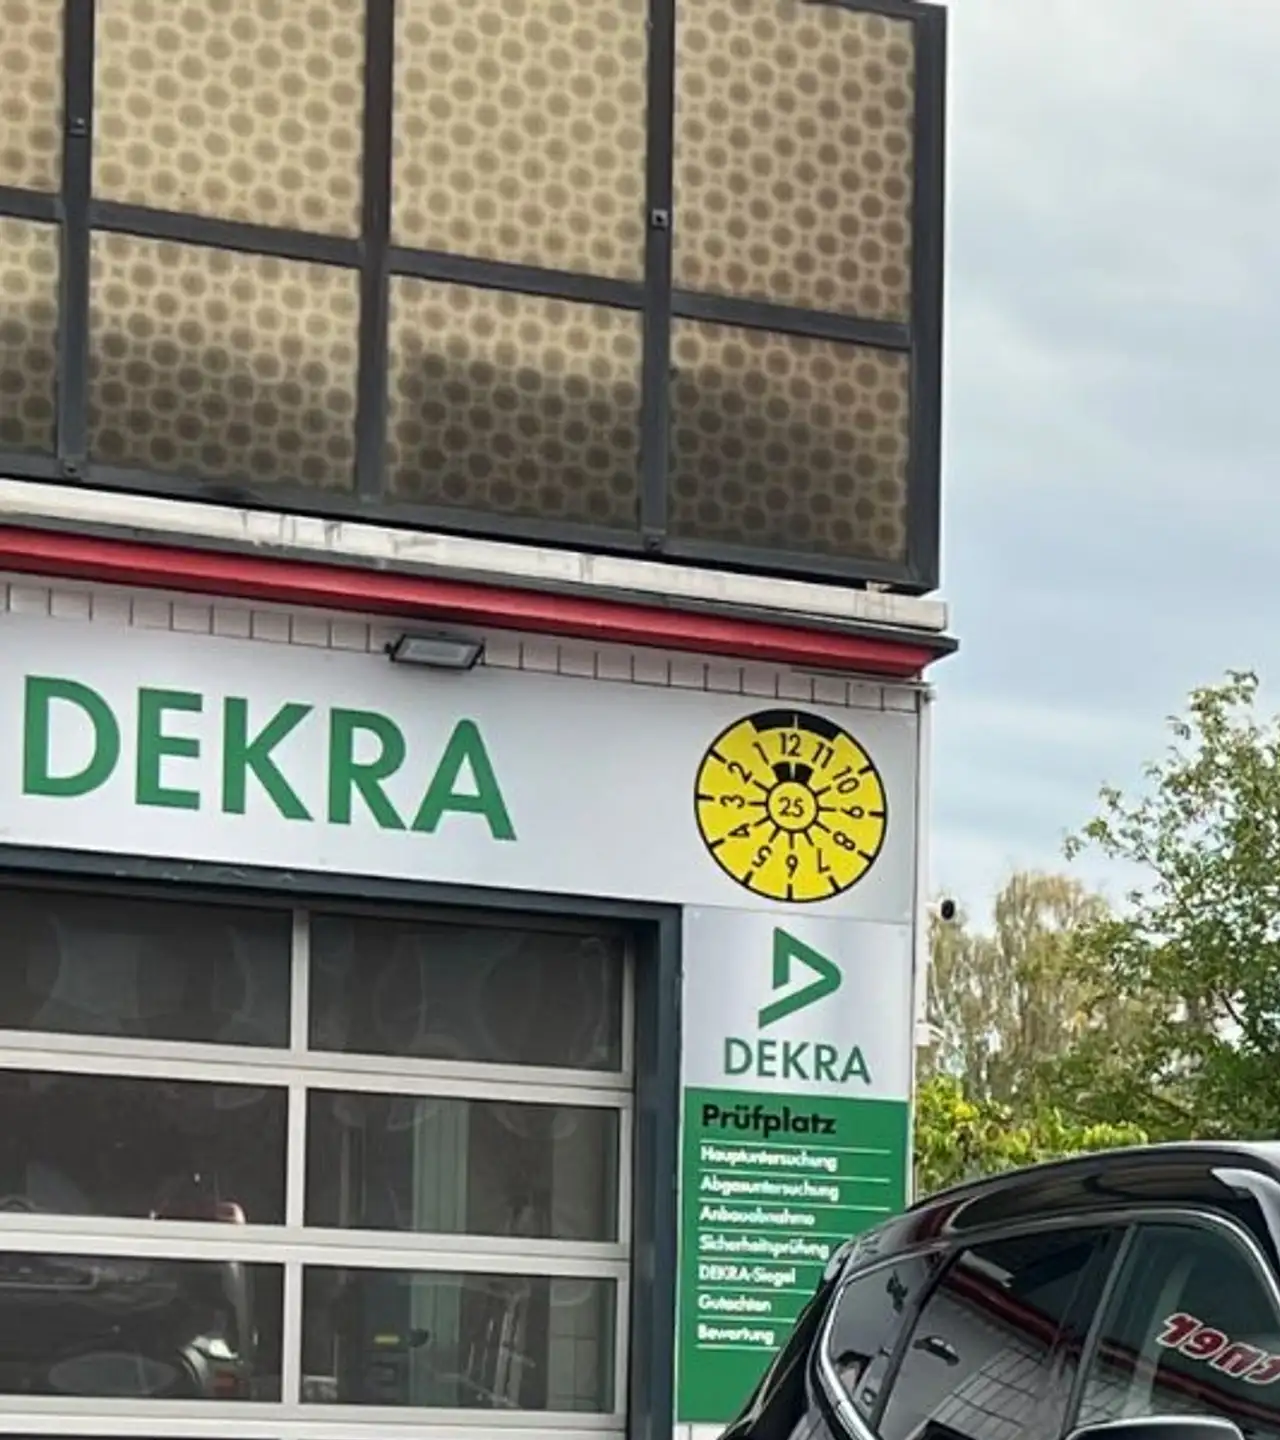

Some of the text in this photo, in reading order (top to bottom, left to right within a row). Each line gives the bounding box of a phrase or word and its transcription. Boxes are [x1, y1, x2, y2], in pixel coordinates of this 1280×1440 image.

[752, 742, 769, 766] 1
[780, 733, 802, 757] 12
[812, 742, 835, 769] 11
[24, 676, 516, 841] DEKRA
[727, 762, 752, 783] 2
[832, 766, 860, 795] 10
[720, 794, 746, 809] 3
[779, 796, 804, 816] 25
[729, 823, 751, 838] 4
[832, 830, 856, 852] 8
[752, 846, 773, 868] 5
[817, 848, 831, 873] 7
[724, 1038, 871, 1085] DEKRA
[702, 1103, 837, 1138] Prüfplatz
[700, 1146, 838, 1172] Hauptuntersuchung
[700, 1175, 840, 1202] Abgasuntersuchung
[700, 1205, 816, 1226] Anbauabnahme
[698, 1234, 829, 1259] Sicherheitsprüfung
[698, 1263, 796, 1286] DEKRA-Siegel
[698, 1294, 772, 1312] Gutachten
[698, 1324, 774, 1345] Bewertung
